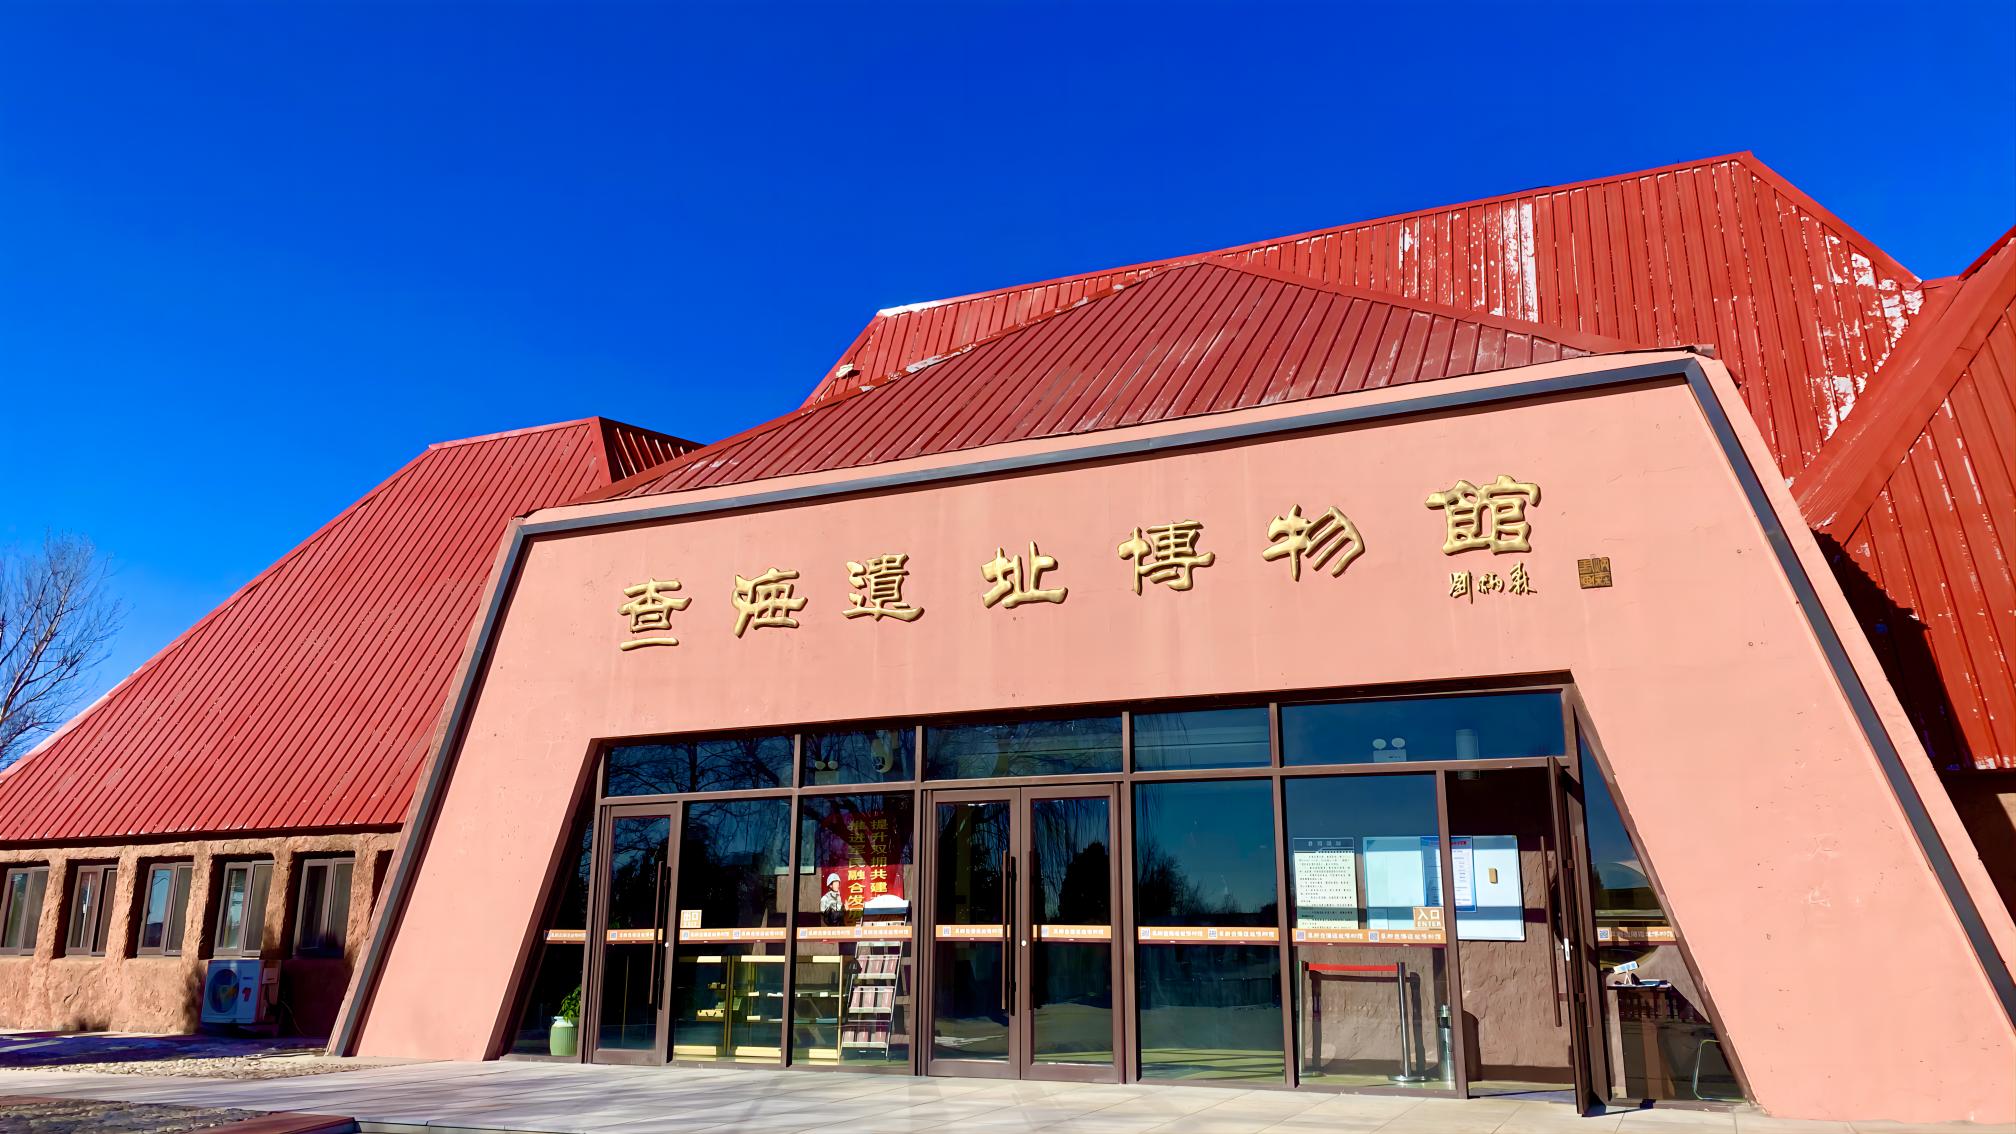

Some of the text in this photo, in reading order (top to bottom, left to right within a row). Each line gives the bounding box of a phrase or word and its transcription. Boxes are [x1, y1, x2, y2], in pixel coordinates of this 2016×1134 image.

[870, 819, 888, 898] 提升双拥共建
[1418, 909, 1440, 920] 入口
[1417, 920, 1441, 928] ENTER
